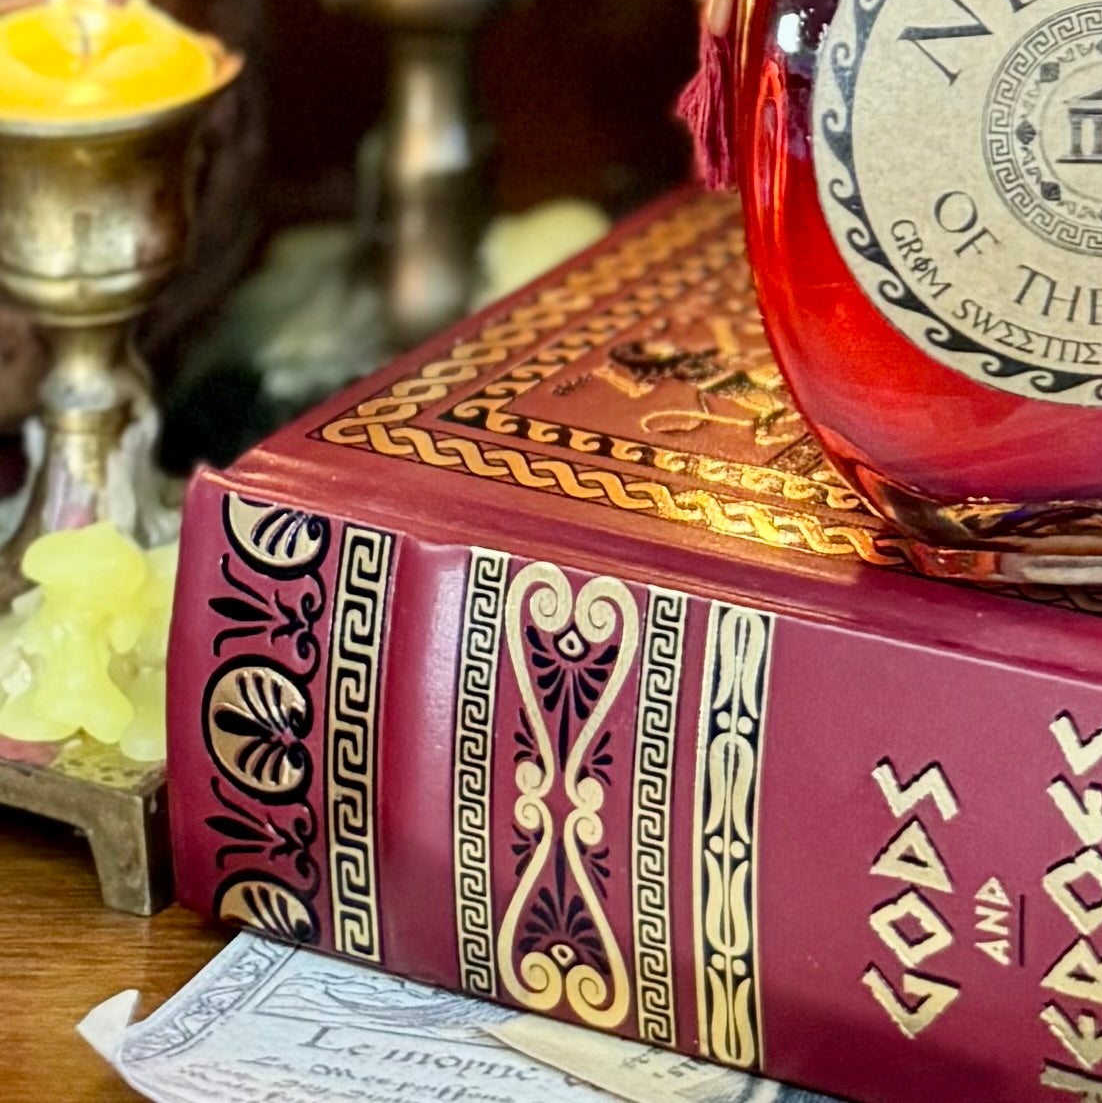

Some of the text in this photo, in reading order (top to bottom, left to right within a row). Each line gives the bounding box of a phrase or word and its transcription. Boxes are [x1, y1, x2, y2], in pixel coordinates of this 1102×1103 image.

[933, 189, 1001, 258] OF
[861, 758, 960, 1039] GODS
[974, 876, 1012, 966] AND
